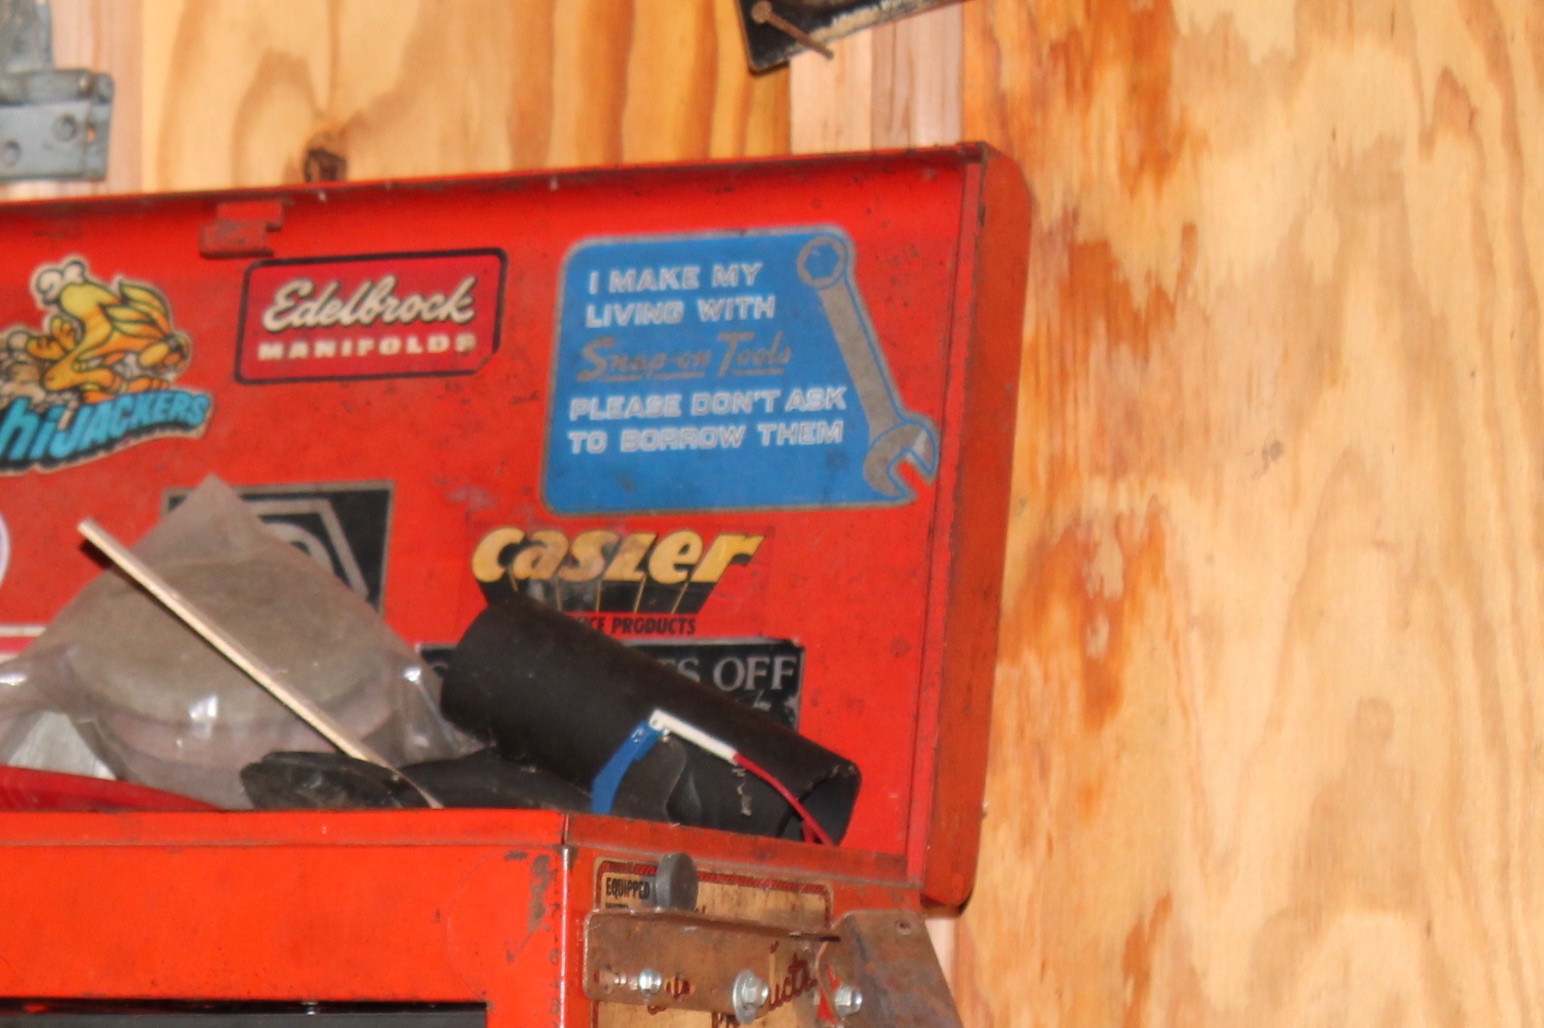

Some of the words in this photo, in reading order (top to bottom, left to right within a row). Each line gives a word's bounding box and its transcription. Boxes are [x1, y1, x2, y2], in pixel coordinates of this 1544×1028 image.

[588, 271, 599, 295] I
[609, 266, 700, 293] MAKE
[712, 263, 763, 288] MY
[262, 273, 477, 332] Edelbrock
[585, 301, 685, 329] LIVING
[697, 295, 776, 322] WITH
[258, 333, 477, 362] MANIFOLDS
[575, 335, 712, 382] Snap-on
[714, 330, 793, 377] Tools
[569, 393, 683, 421] PLEASE
[691, 389, 783, 416] DON'T
[785, 386, 847, 412] ASK
[568, 430, 607, 454] TO
[620, 425, 746, 453] BORROW
[756, 419, 844, 447] THEM
[611, 617, 696, 635] PRODUCTS
[713, 656, 797, 692] OFF
[606, 876, 651, 900] EQUIPPED
